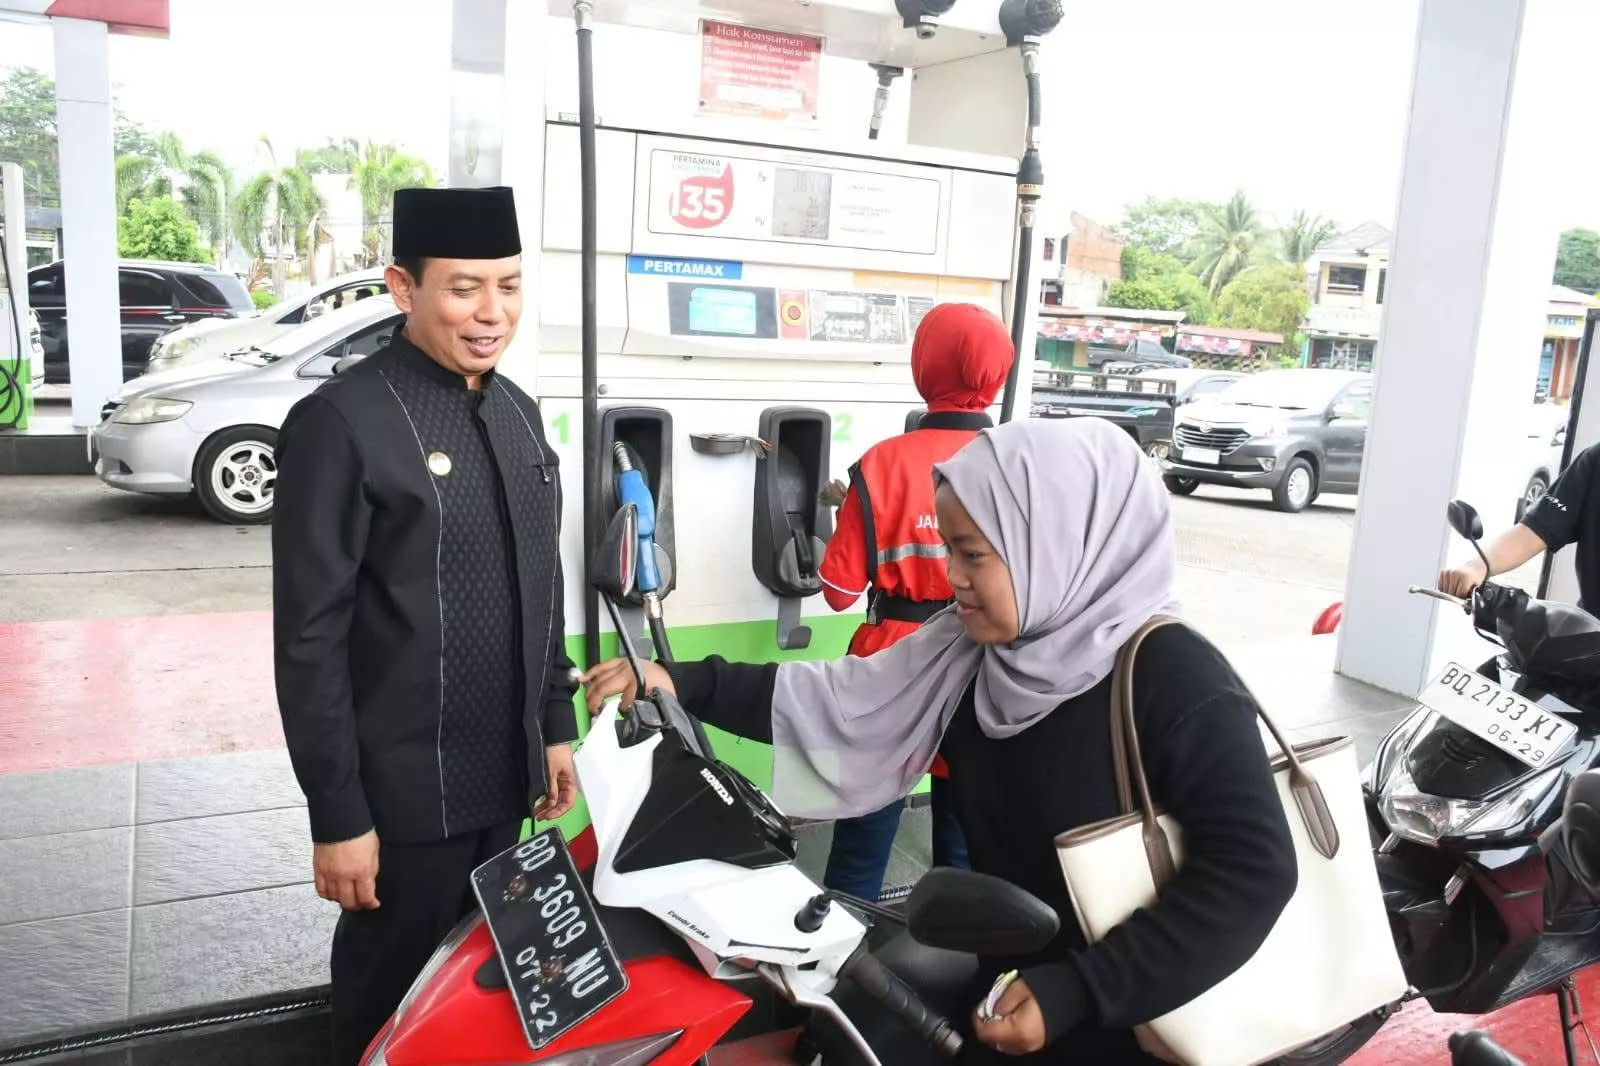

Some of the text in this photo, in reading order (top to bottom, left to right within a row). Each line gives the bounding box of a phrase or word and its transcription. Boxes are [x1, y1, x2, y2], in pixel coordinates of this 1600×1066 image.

[716, 24, 804, 47] Hak Konsumen
[673, 155, 721, 167] PERTAMINA
[671, 183, 724, 220] 135
[643, 260, 724, 277] PERTAMAX
[551, 412, 570, 444] 1
[831, 414, 853, 441] 2
[1440, 667, 1562, 741] BD 2133 KI
[700, 767, 735, 807] HONDA
[514, 834, 610, 999] BD 3609 NU
